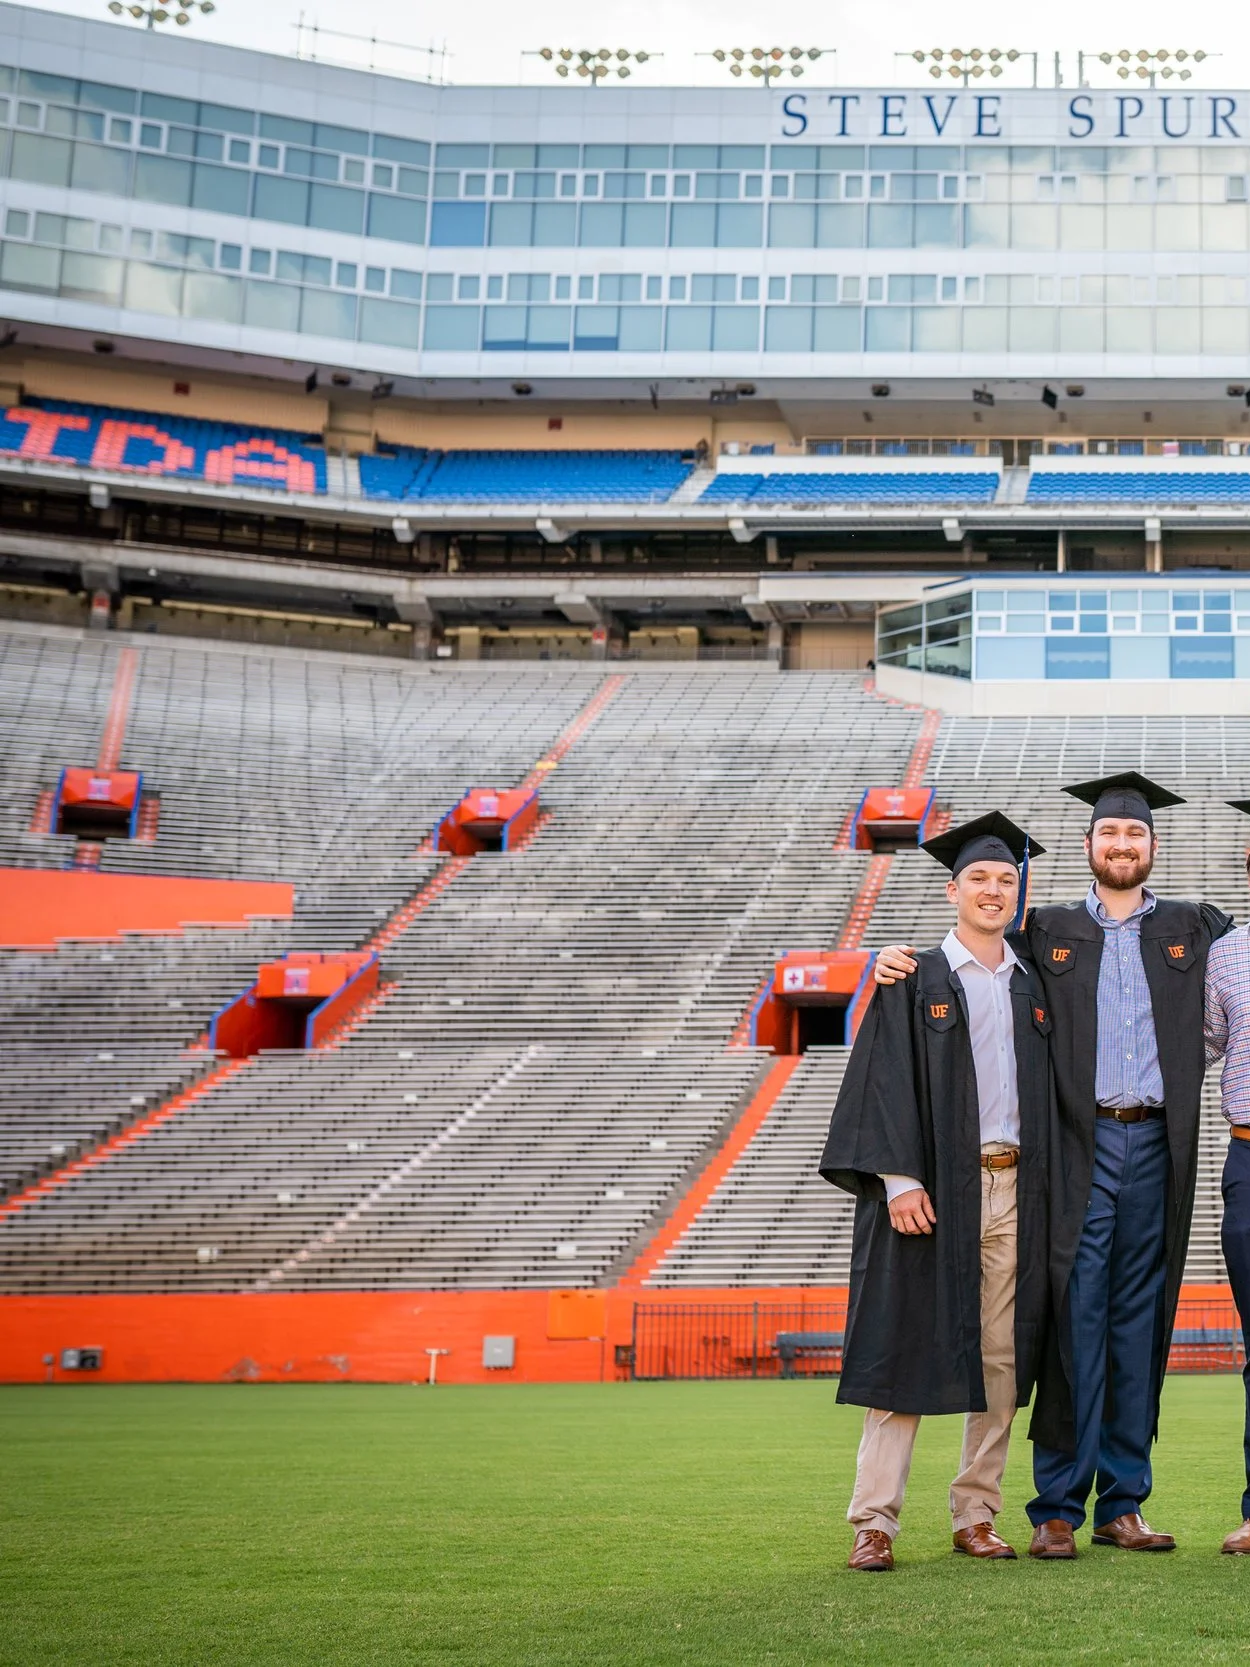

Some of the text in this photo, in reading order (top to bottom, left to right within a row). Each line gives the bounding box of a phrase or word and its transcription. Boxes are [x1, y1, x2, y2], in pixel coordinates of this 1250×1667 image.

[781, 93, 1002, 138] STEVE
[1052, 948, 1071, 962] UF
[1168, 944, 1185, 959] UF
[929, 1004, 949, 1019] UF
